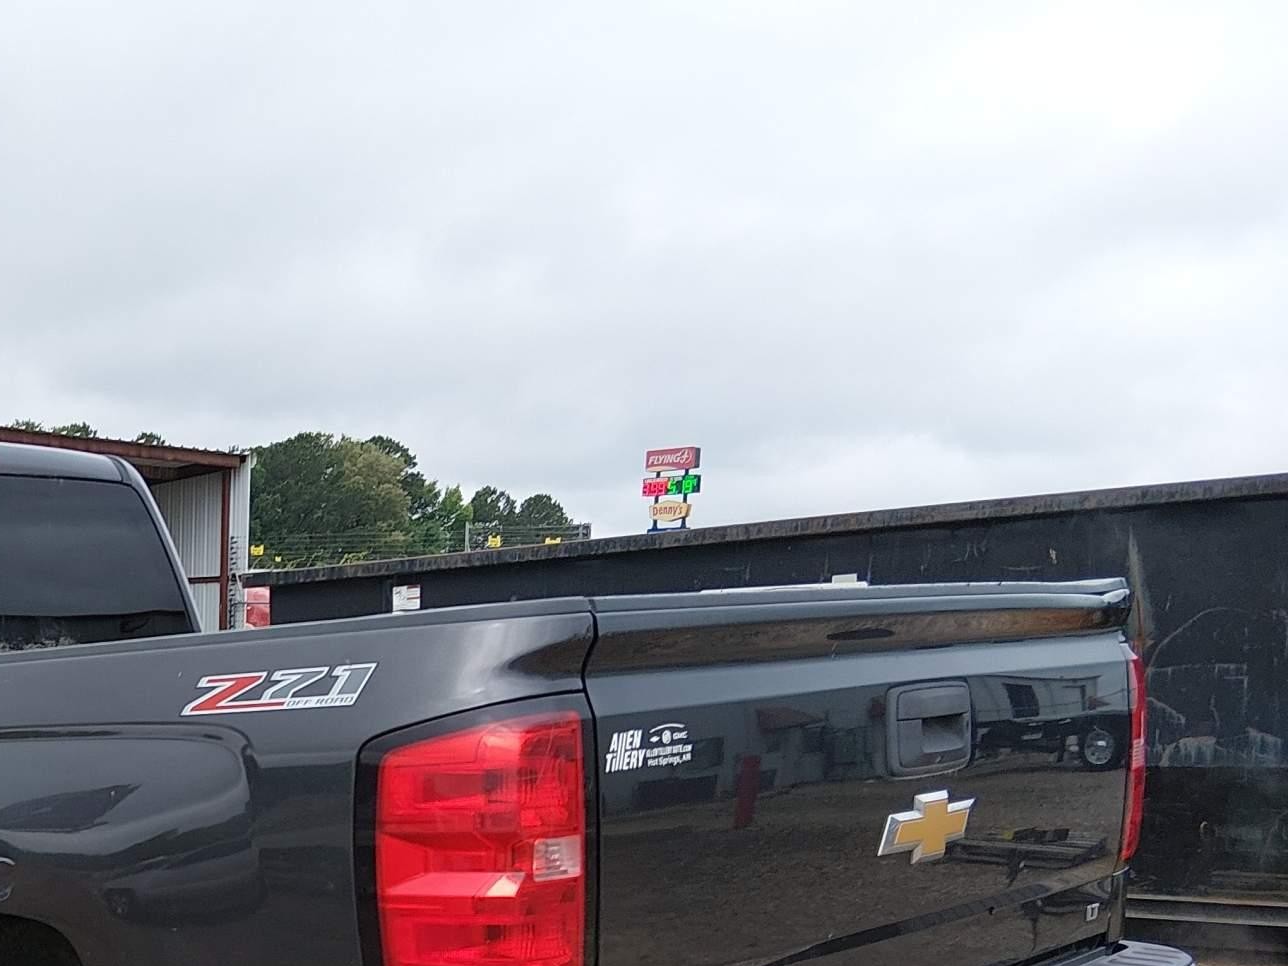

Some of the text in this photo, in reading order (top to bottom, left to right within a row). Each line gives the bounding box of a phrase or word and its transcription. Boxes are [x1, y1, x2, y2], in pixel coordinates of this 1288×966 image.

[648, 452, 681, 465] FLYING
[653, 504, 682, 516] Denny's
[180, 662, 378, 716] Z71
[286, 695, 354, 708] OFF ROAD
